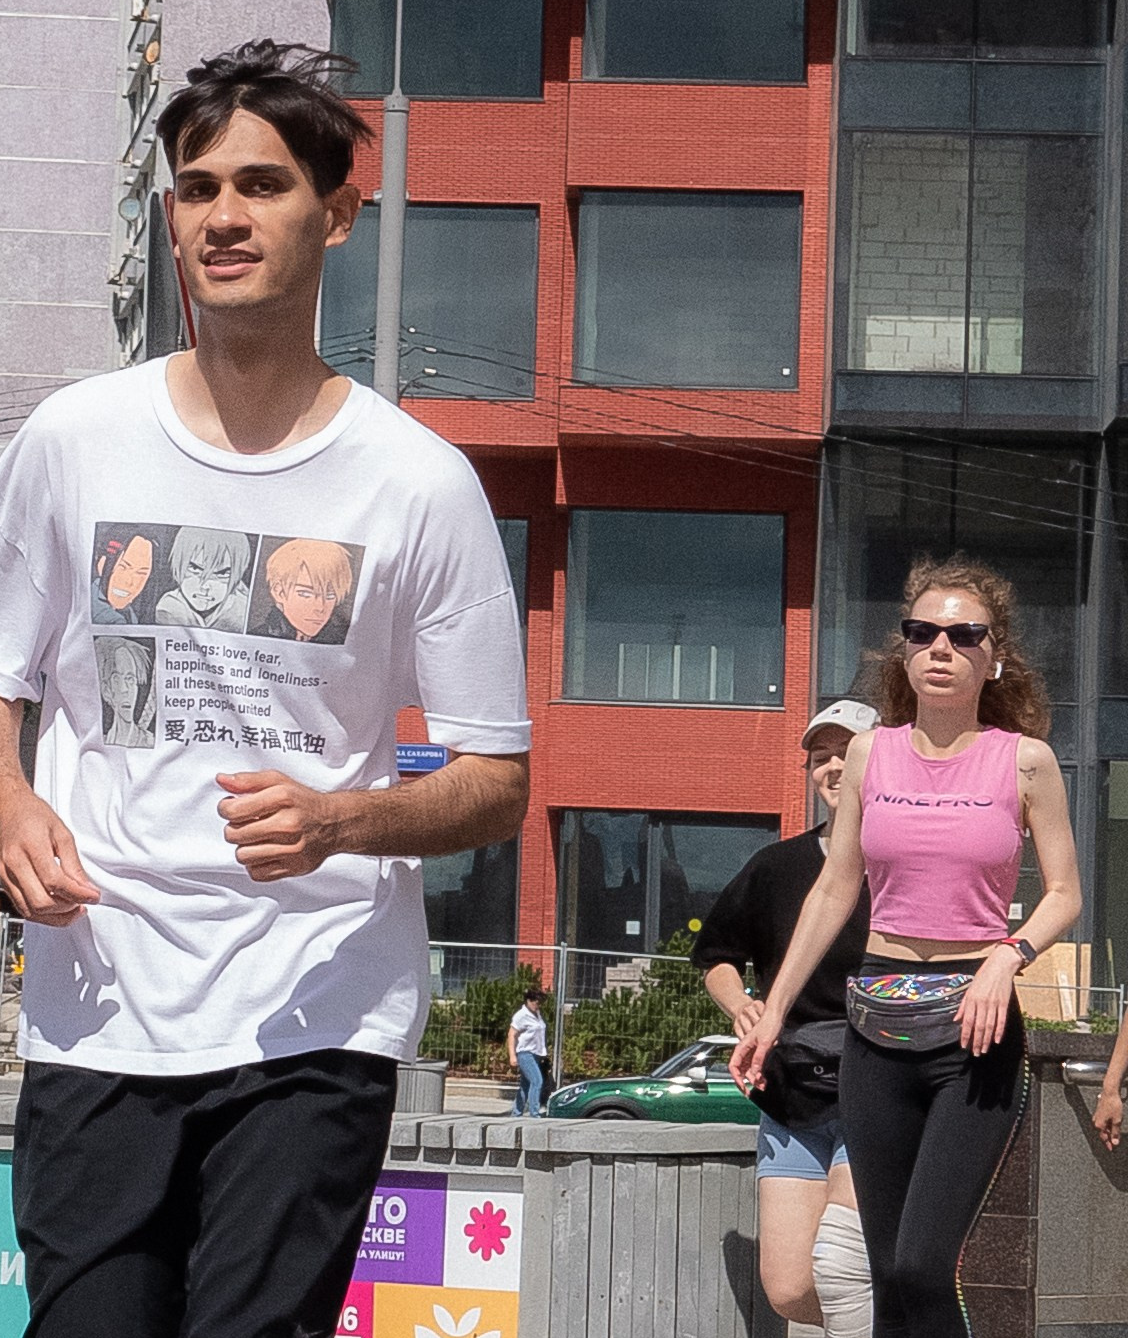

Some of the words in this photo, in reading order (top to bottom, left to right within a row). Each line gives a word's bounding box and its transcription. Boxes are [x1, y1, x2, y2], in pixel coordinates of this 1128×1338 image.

[222, 645, 251, 662] love,
[254, 650, 282, 667] fear,
[230, 667, 252, 679] and
[258, 667, 320, 687] loneliness
[165, 677, 180, 689] all
[184, 677, 216, 691] these
[217, 683, 270, 698] emotions
[164, 695, 196, 711] keep
[198, 697, 236, 712] people
[875, 793, 930, 808] NIKE
[935, 795, 994, 808] PRO
[368, 1249, 405, 1262] УЛИЦУ!
[0, 1250, 26, 1286] И
[337, 1305, 358, 1332] 6
